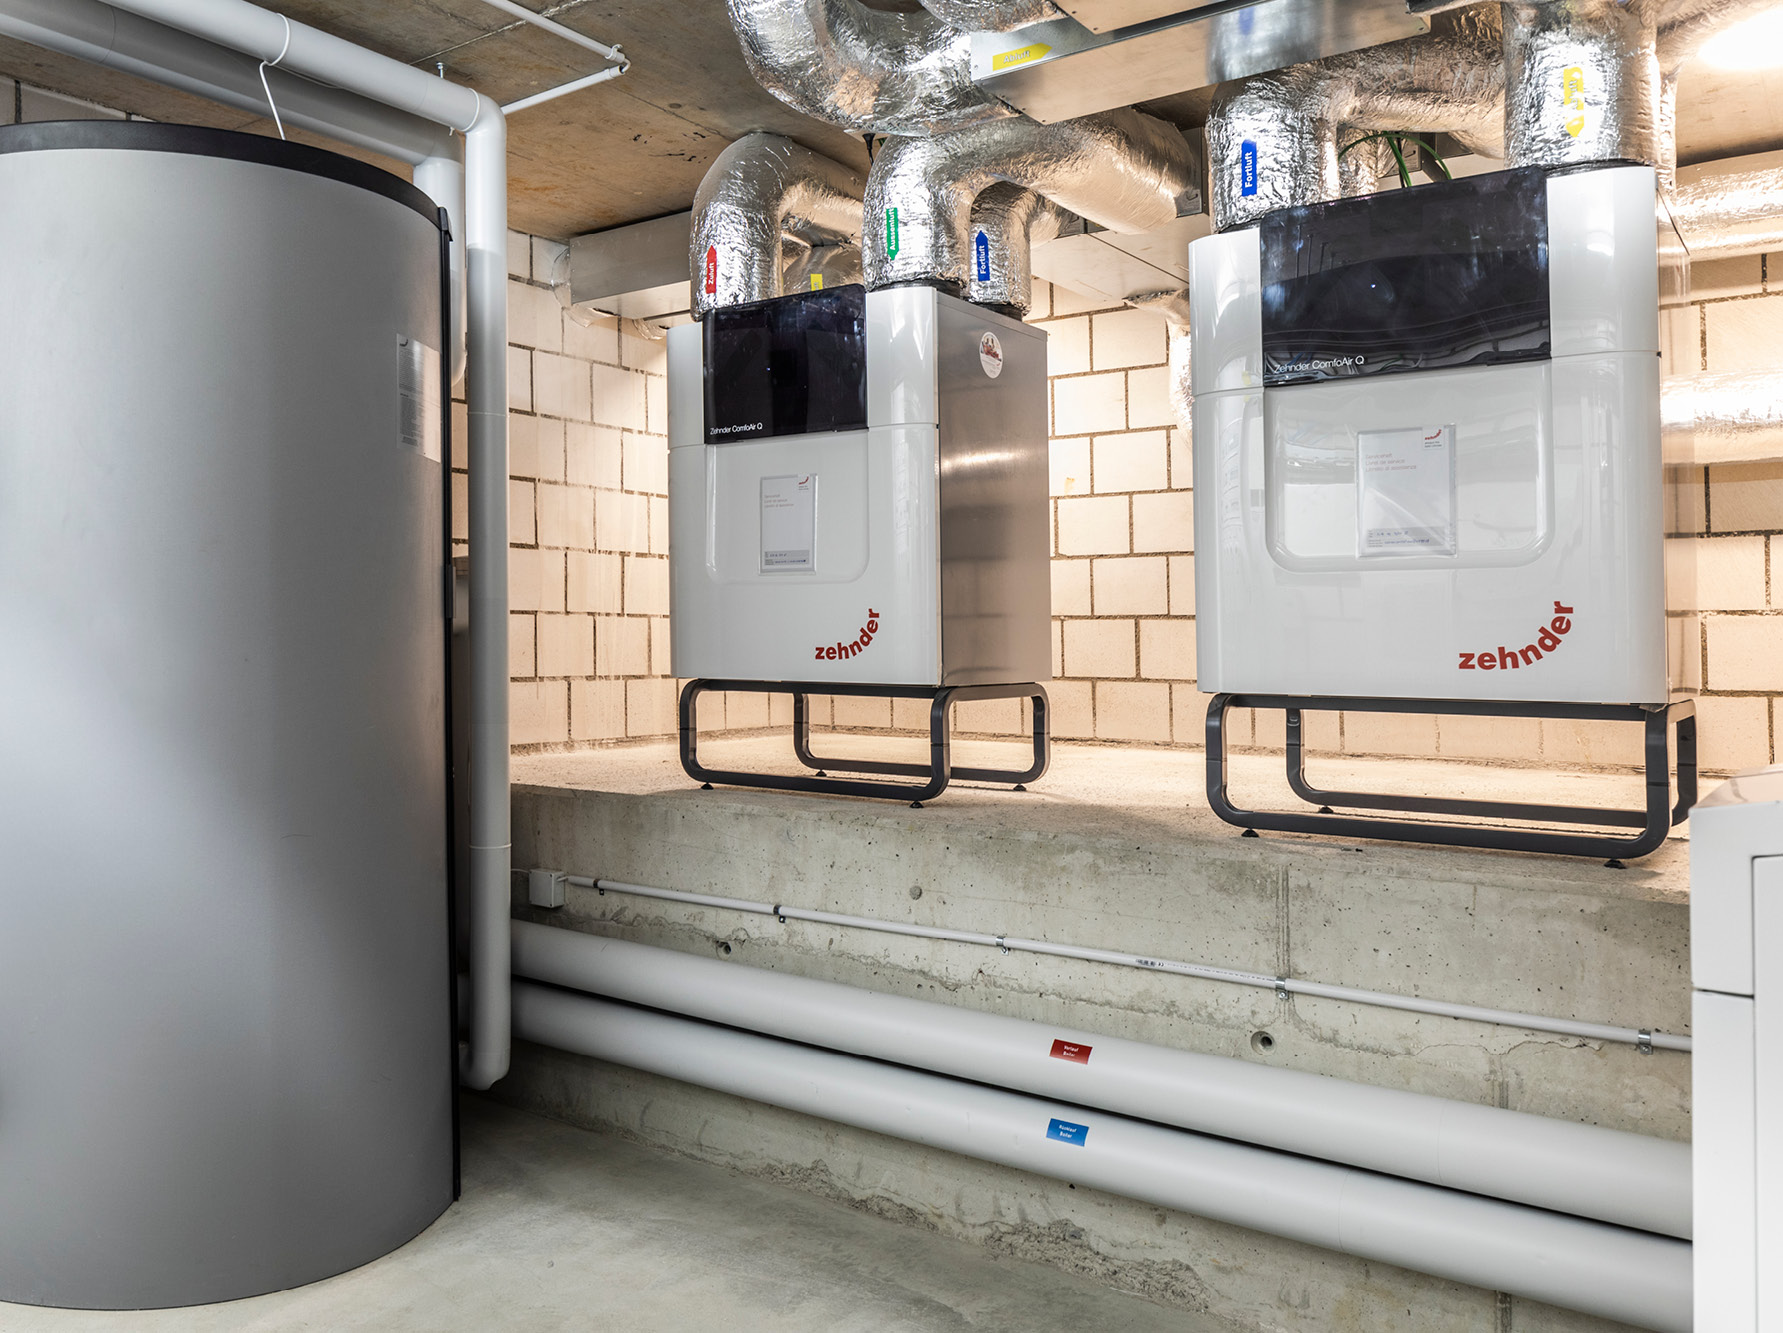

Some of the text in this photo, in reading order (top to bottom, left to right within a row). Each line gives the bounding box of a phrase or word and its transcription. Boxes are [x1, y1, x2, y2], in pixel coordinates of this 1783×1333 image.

[1003, 50, 1030, 64] Abluft
[1245, 151, 1253, 188] Fortluft
[1274, 355, 1365, 374] Zehnder ComfoAir Q
[710, 422, 763, 435] Zehnder ComfoAir Q
[815, 608, 880, 660] zehnder
[1458, 601, 1574, 670] zehnder
